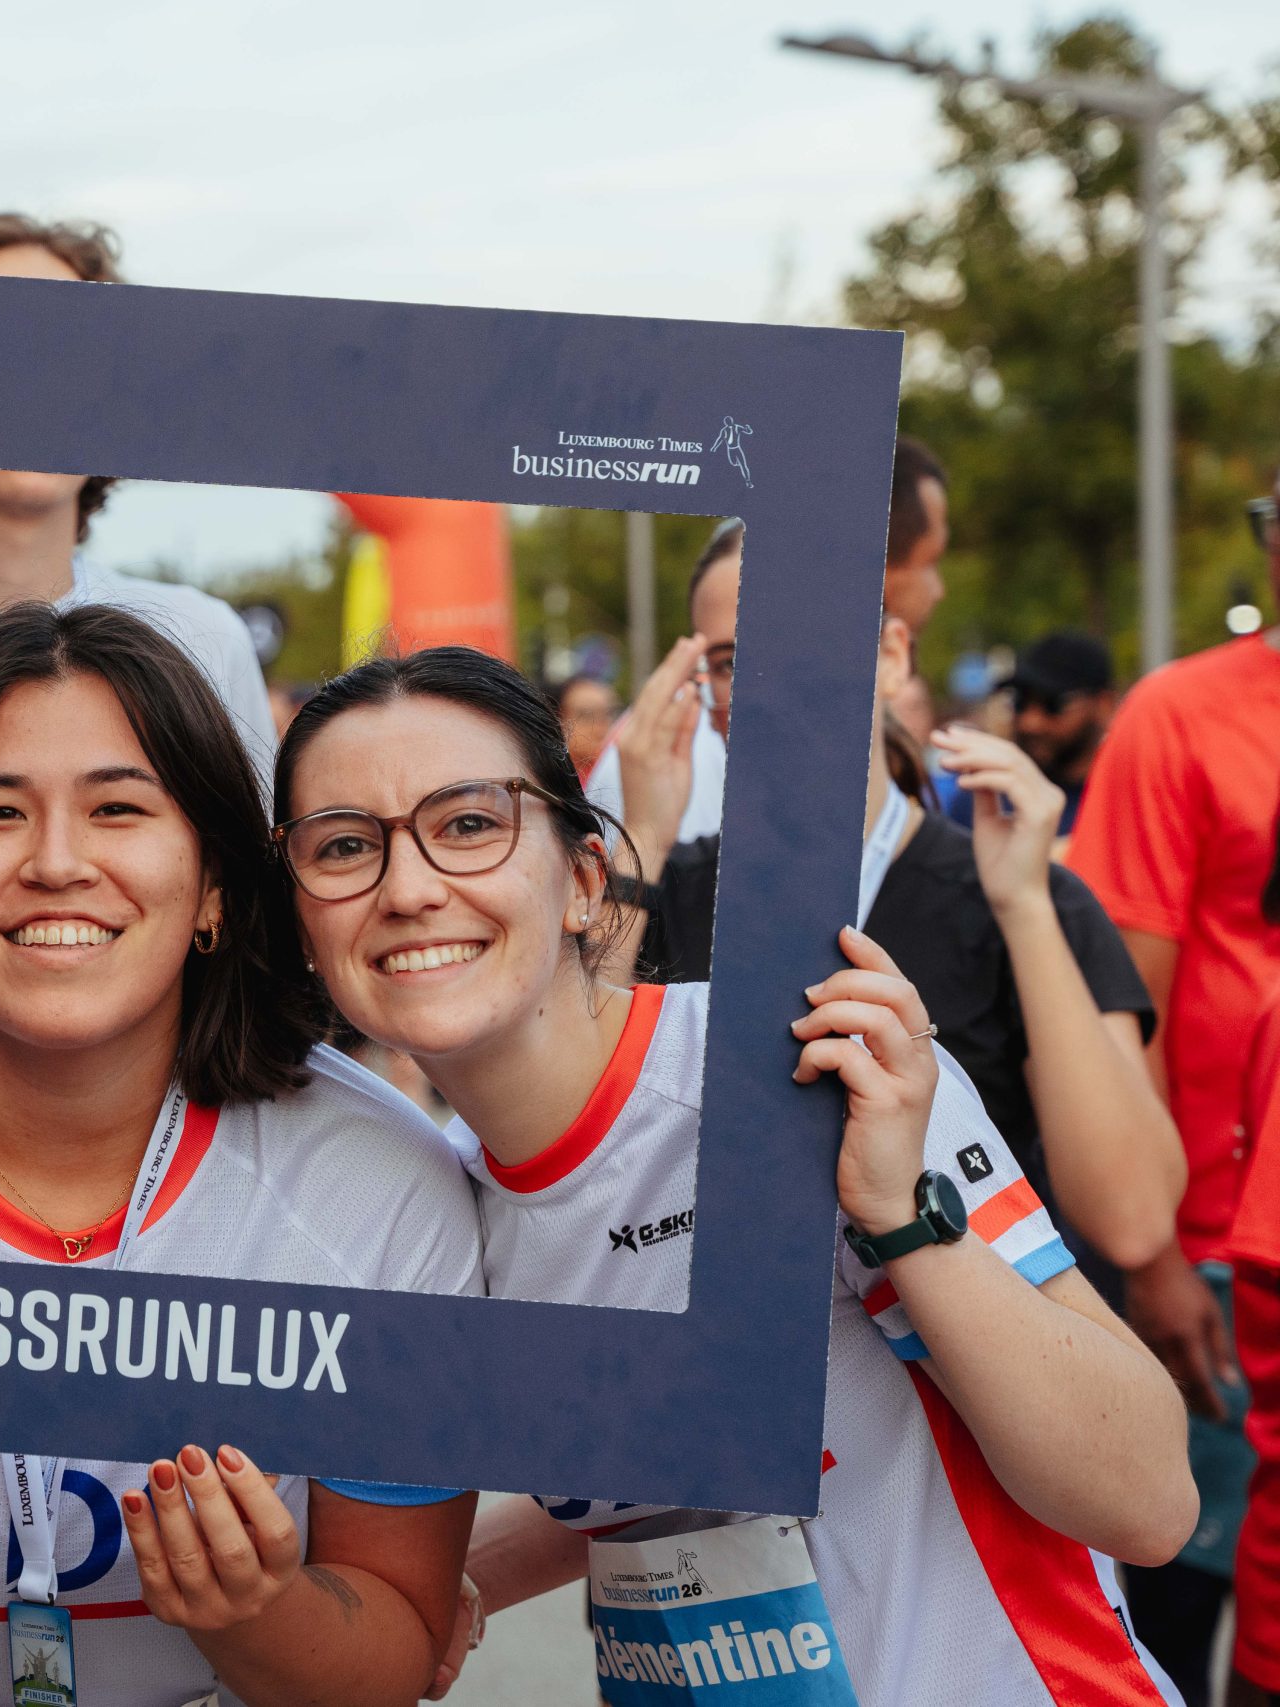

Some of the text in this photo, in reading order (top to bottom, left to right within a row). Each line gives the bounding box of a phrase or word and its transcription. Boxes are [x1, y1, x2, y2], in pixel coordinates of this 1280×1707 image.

[558, 431, 703, 453] LUXEMBOURG TIMES
[512, 445, 701, 485] businessrun
[136, 1094, 183, 1212] LUXEMBOURG TIMES
[638, 1209, 694, 1242] G-SKI
[13, 1453, 34, 1528] LUXEMBOU
[647, 1571, 674, 1583] TIMES
[600, 1580, 702, 1602] businessrun 26
[24, 1689, 63, 1704] FINISHER
